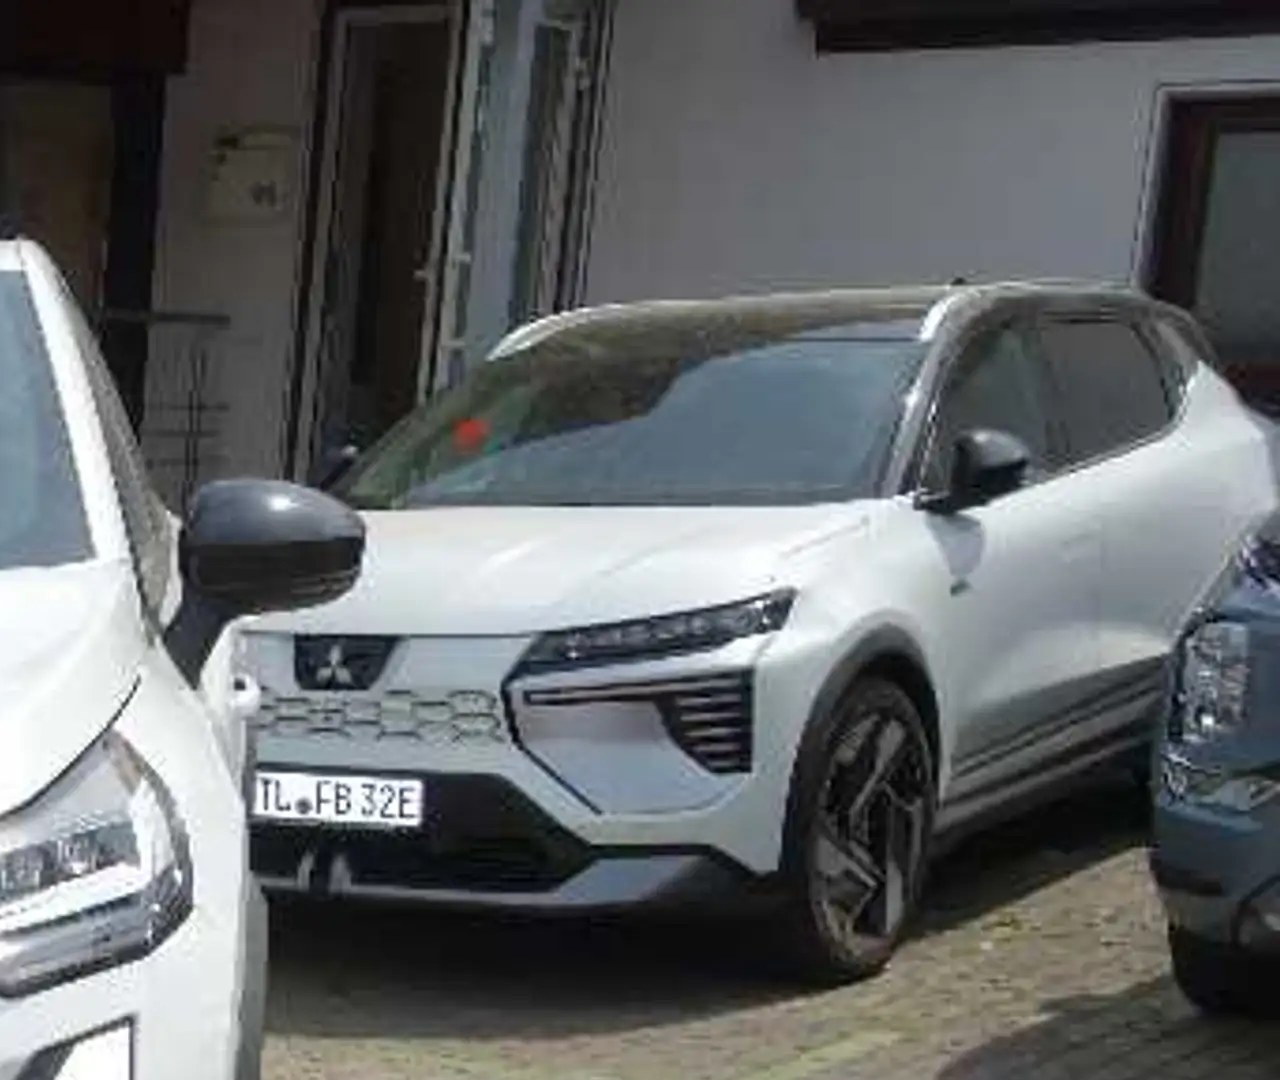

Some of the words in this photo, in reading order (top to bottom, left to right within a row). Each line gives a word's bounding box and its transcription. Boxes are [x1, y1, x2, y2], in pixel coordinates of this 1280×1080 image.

[260, 777, 292, 812] TL
[315, 780, 352, 816] FB
[360, 783, 417, 819] 32E
